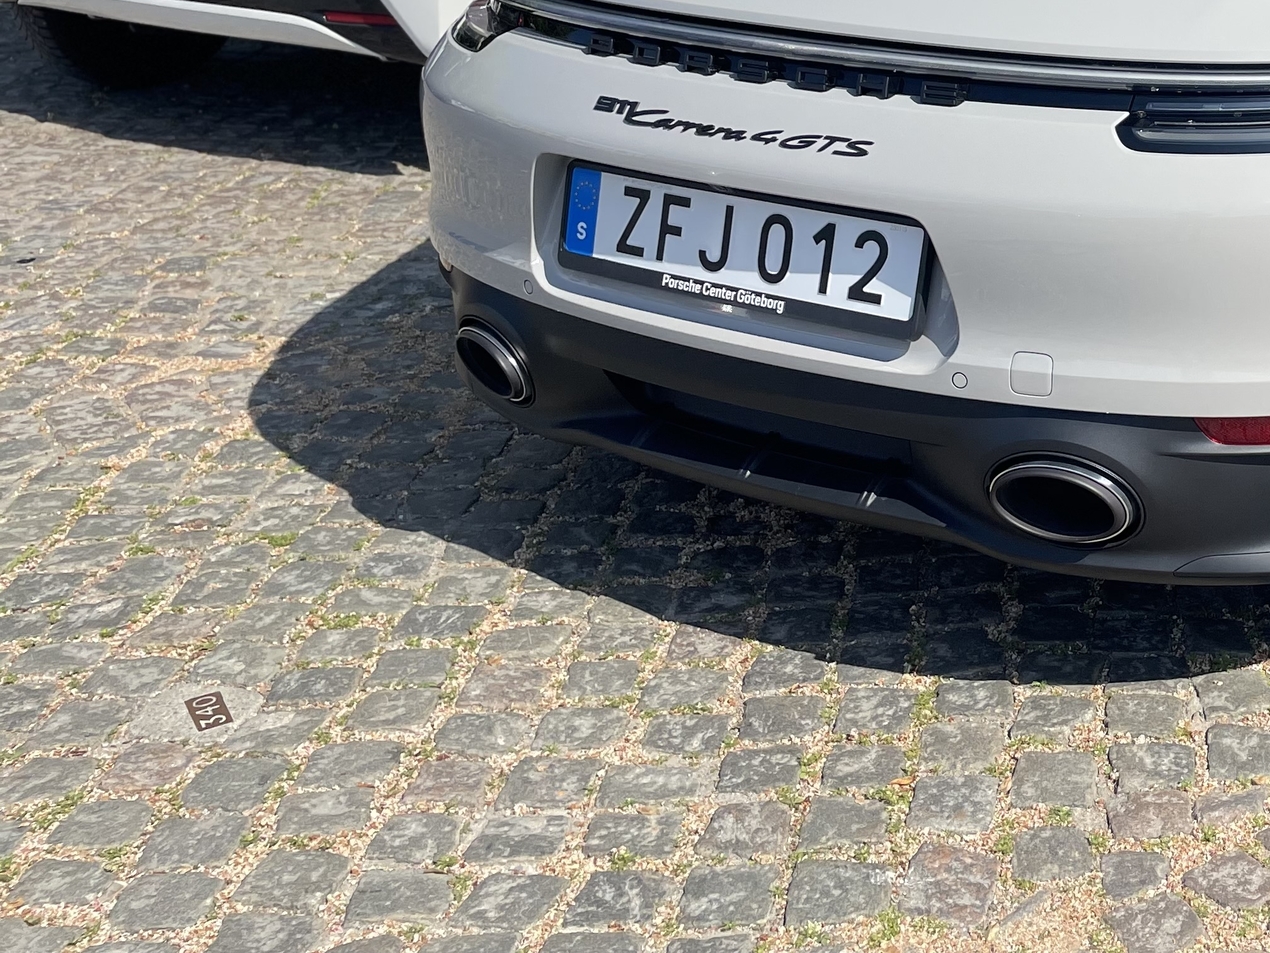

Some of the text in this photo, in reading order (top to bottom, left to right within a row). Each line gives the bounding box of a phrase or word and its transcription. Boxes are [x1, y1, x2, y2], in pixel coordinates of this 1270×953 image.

[586, 33, 967, 106] PORSCHE
[623, 109, 747, 142] Carrera
[750, 130, 784, 145] 4
[778, 134, 875, 157] GTS
[576, 221, 588, 241] S
[616, 185, 889, 305] ZFJ 012
[661, 273, 702, 295] Porsche
[702, 281, 737, 302] Center
[737, 288, 786, 315] Göteborg
[193, 696, 227, 729] 340
